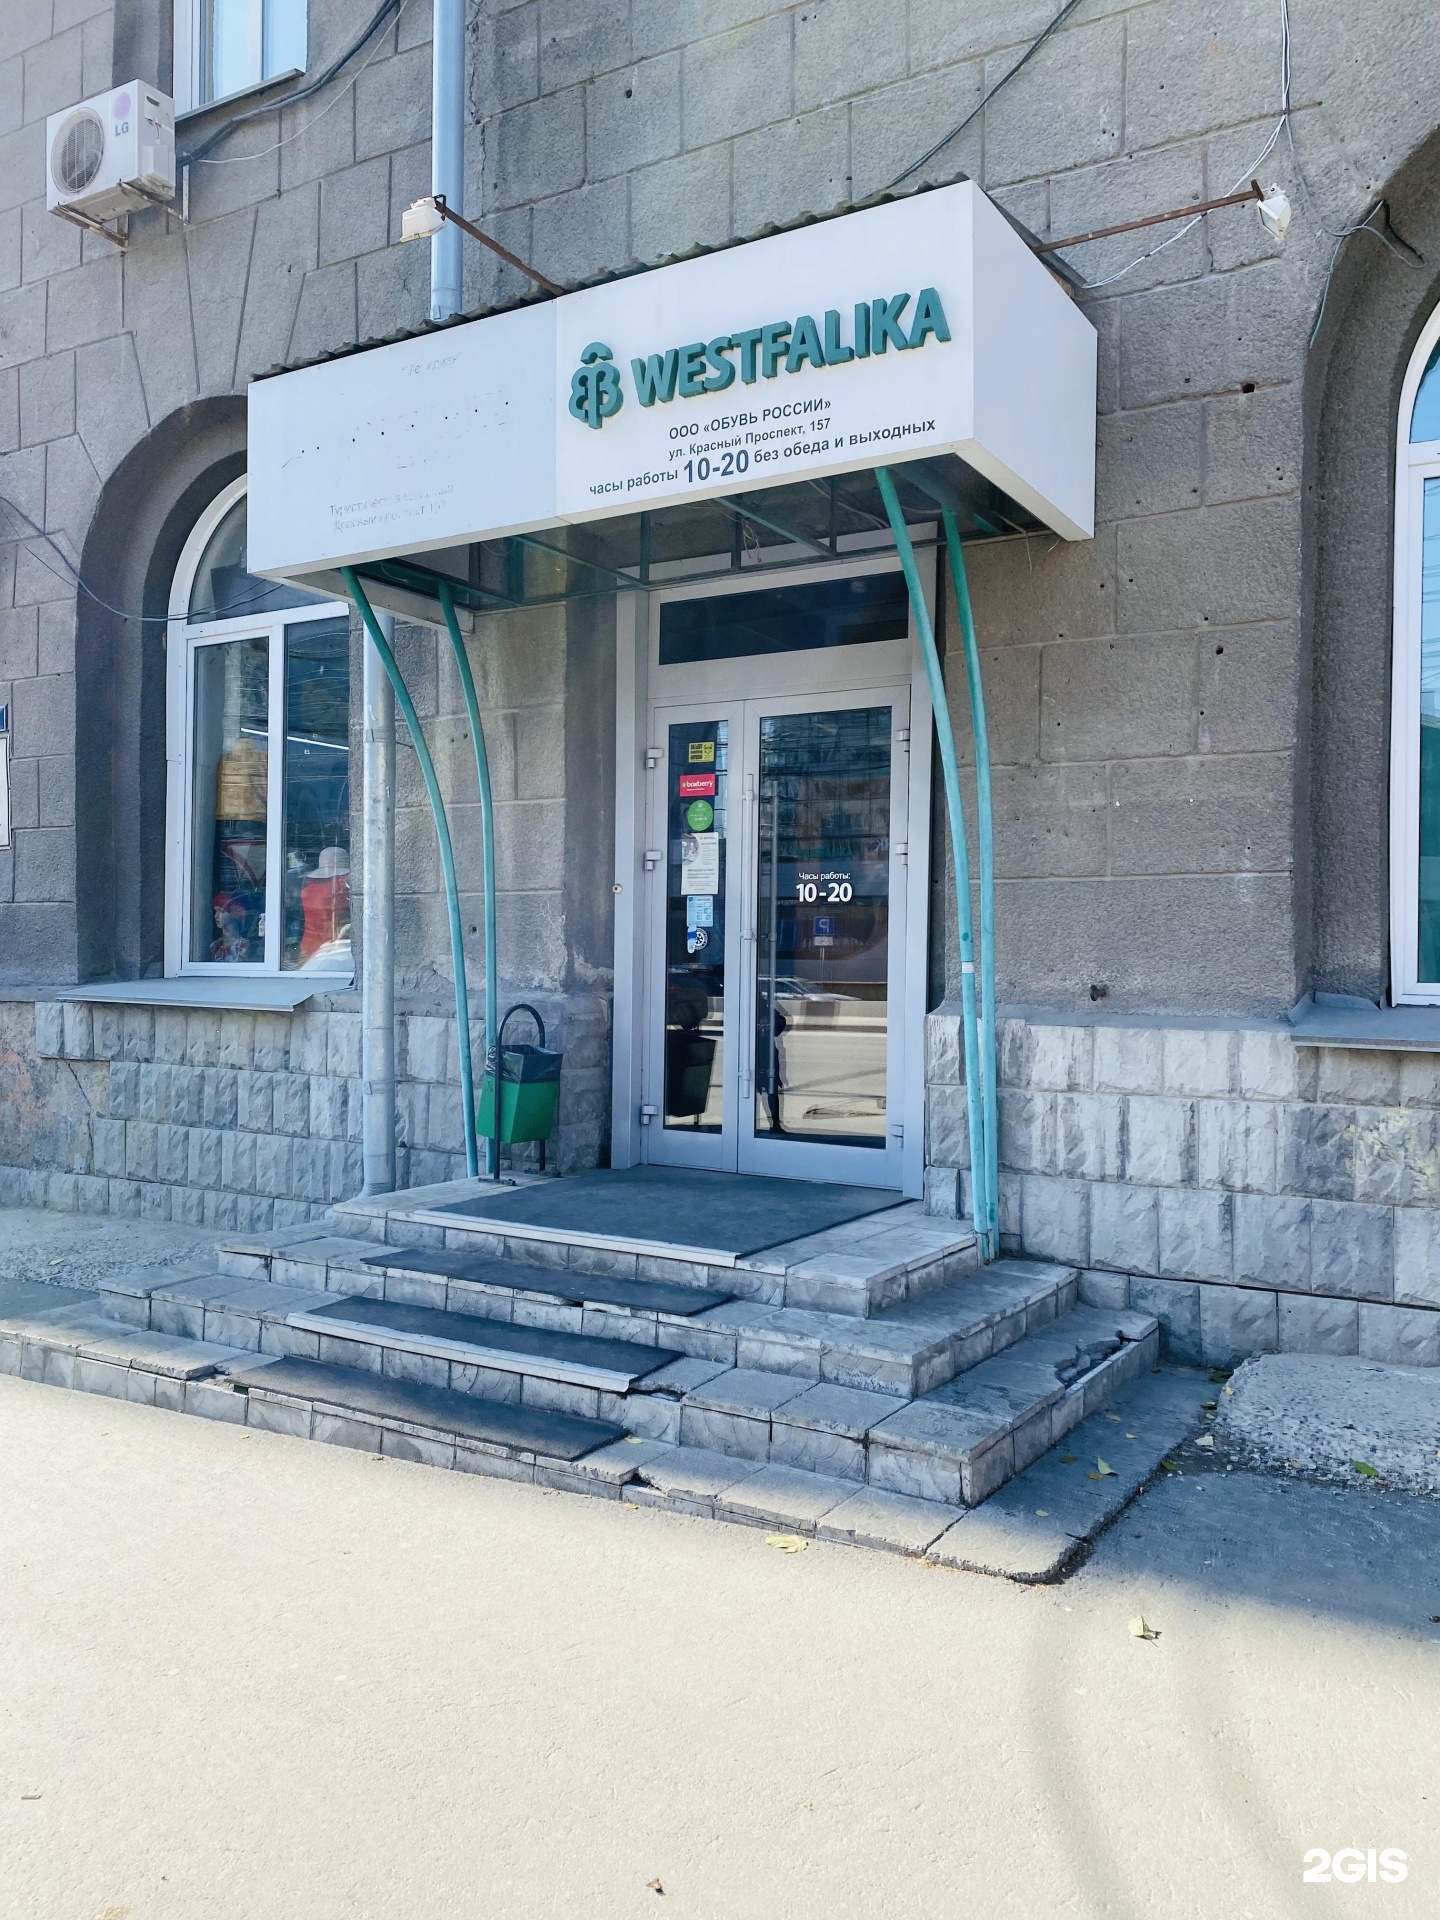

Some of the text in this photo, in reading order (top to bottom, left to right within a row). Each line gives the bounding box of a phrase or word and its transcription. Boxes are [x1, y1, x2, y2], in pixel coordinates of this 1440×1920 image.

[115, 121, 129, 137] LG
[630, 287, 951, 408] WESTFALIKA
[669, 398, 831, 440] ООО «ОБУВЬ РОССИИ»
[669, 418, 831, 461] ул. Красный Проспект, 157
[589, 419, 936, 495] часы работы 10-20 без обеда и выходных
[329, 494, 401, 517] Туристиеся
[686, 780, 714, 788] boxberry
[798, 871, 851, 882] Часы работы:
